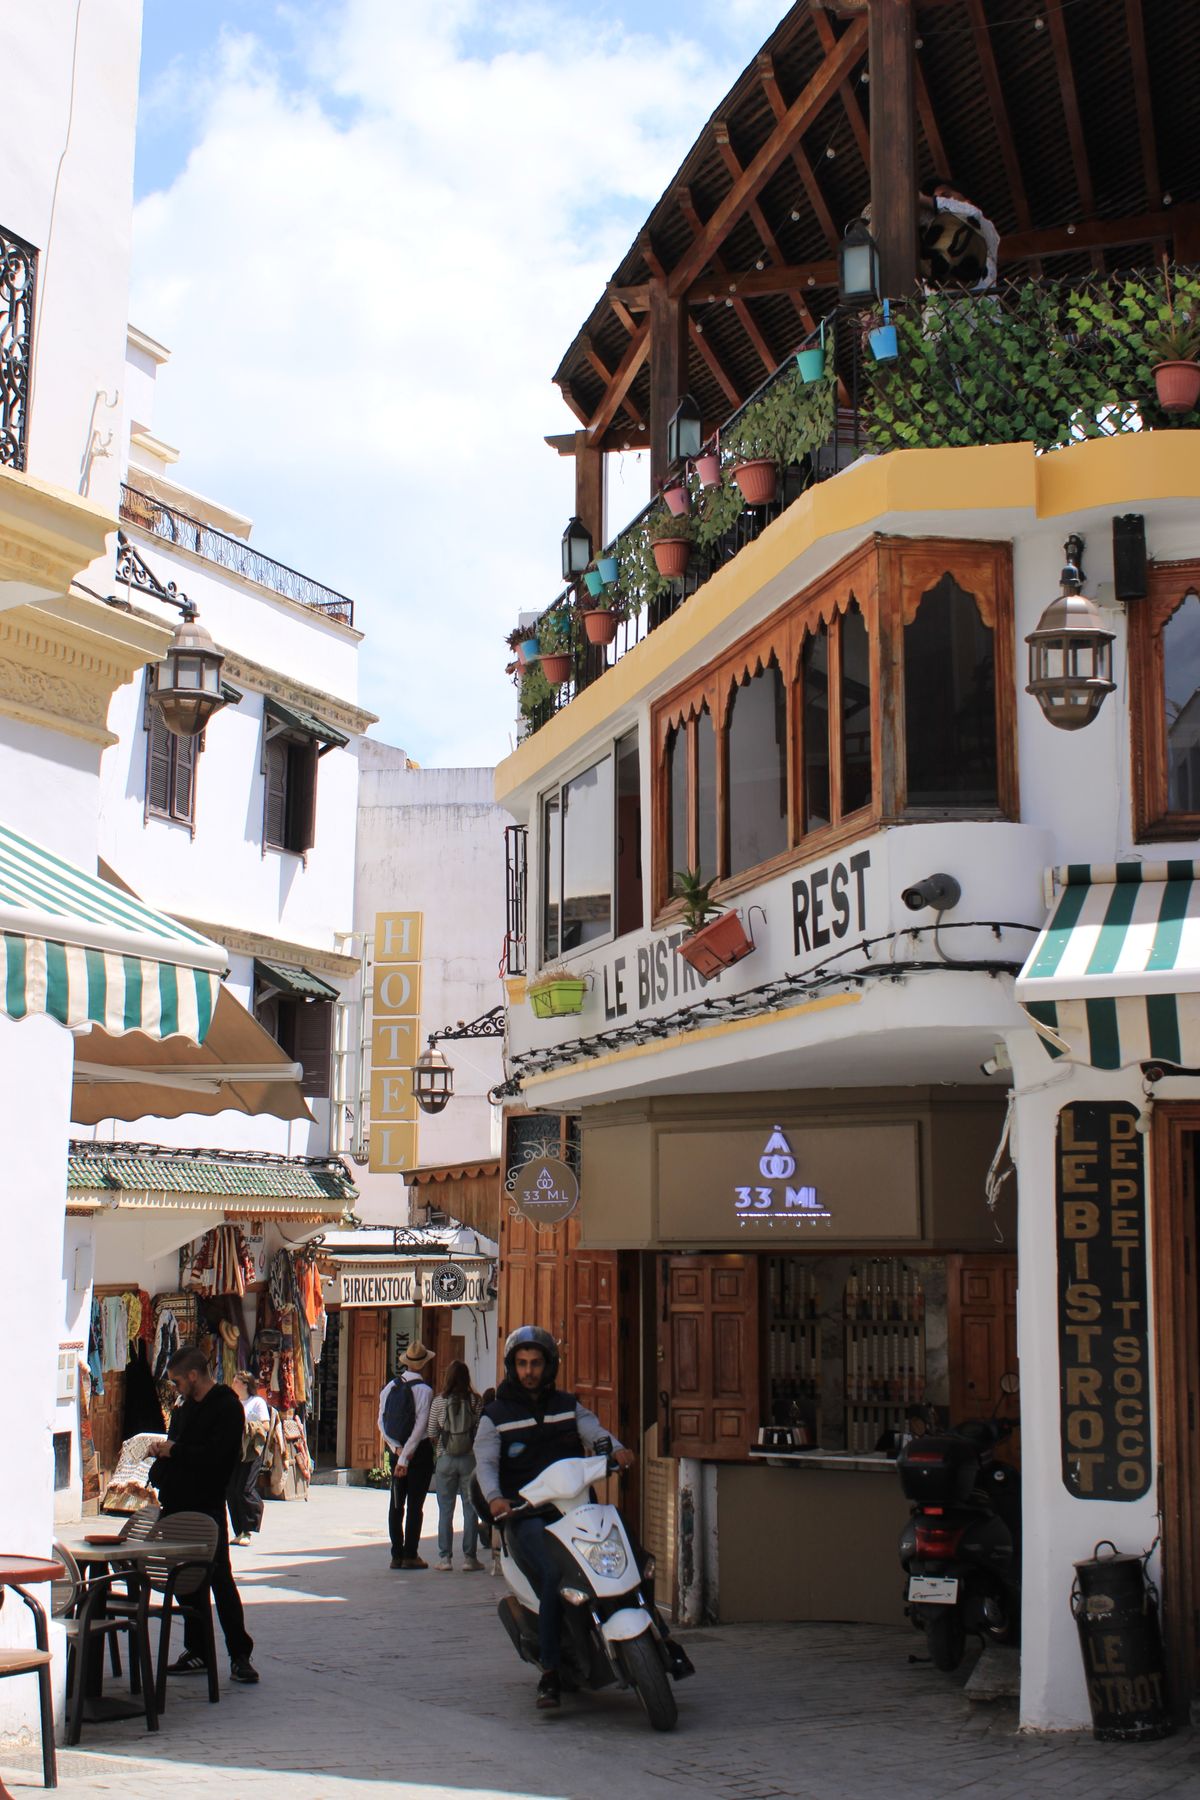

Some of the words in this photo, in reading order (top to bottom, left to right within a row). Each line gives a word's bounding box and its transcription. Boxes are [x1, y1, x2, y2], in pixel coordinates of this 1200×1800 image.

[603, 956, 628, 1022] LE
[637, 928, 722, 1010] BISTR
[791, 850, 871, 957] REST
[378, 918, 416, 1168] HOTEL
[1060, 1109, 1099, 1193] LE
[1109, 1113, 1139, 1170] DE
[523, 1190, 540, 1201] 33
[547, 1189, 569, 1200] ML
[735, 1186, 773, 1209] 33
[785, 1186, 824, 1209] ML
[343, 1276, 412, 1303] BIRKENSTOCK
[1110, 1178, 1141, 1330] PETIT
[1062, 1200, 1105, 1493] BISTROT
[1112, 1335, 1146, 1490] SOCCO
[1088, 1634, 1127, 1673] LE
